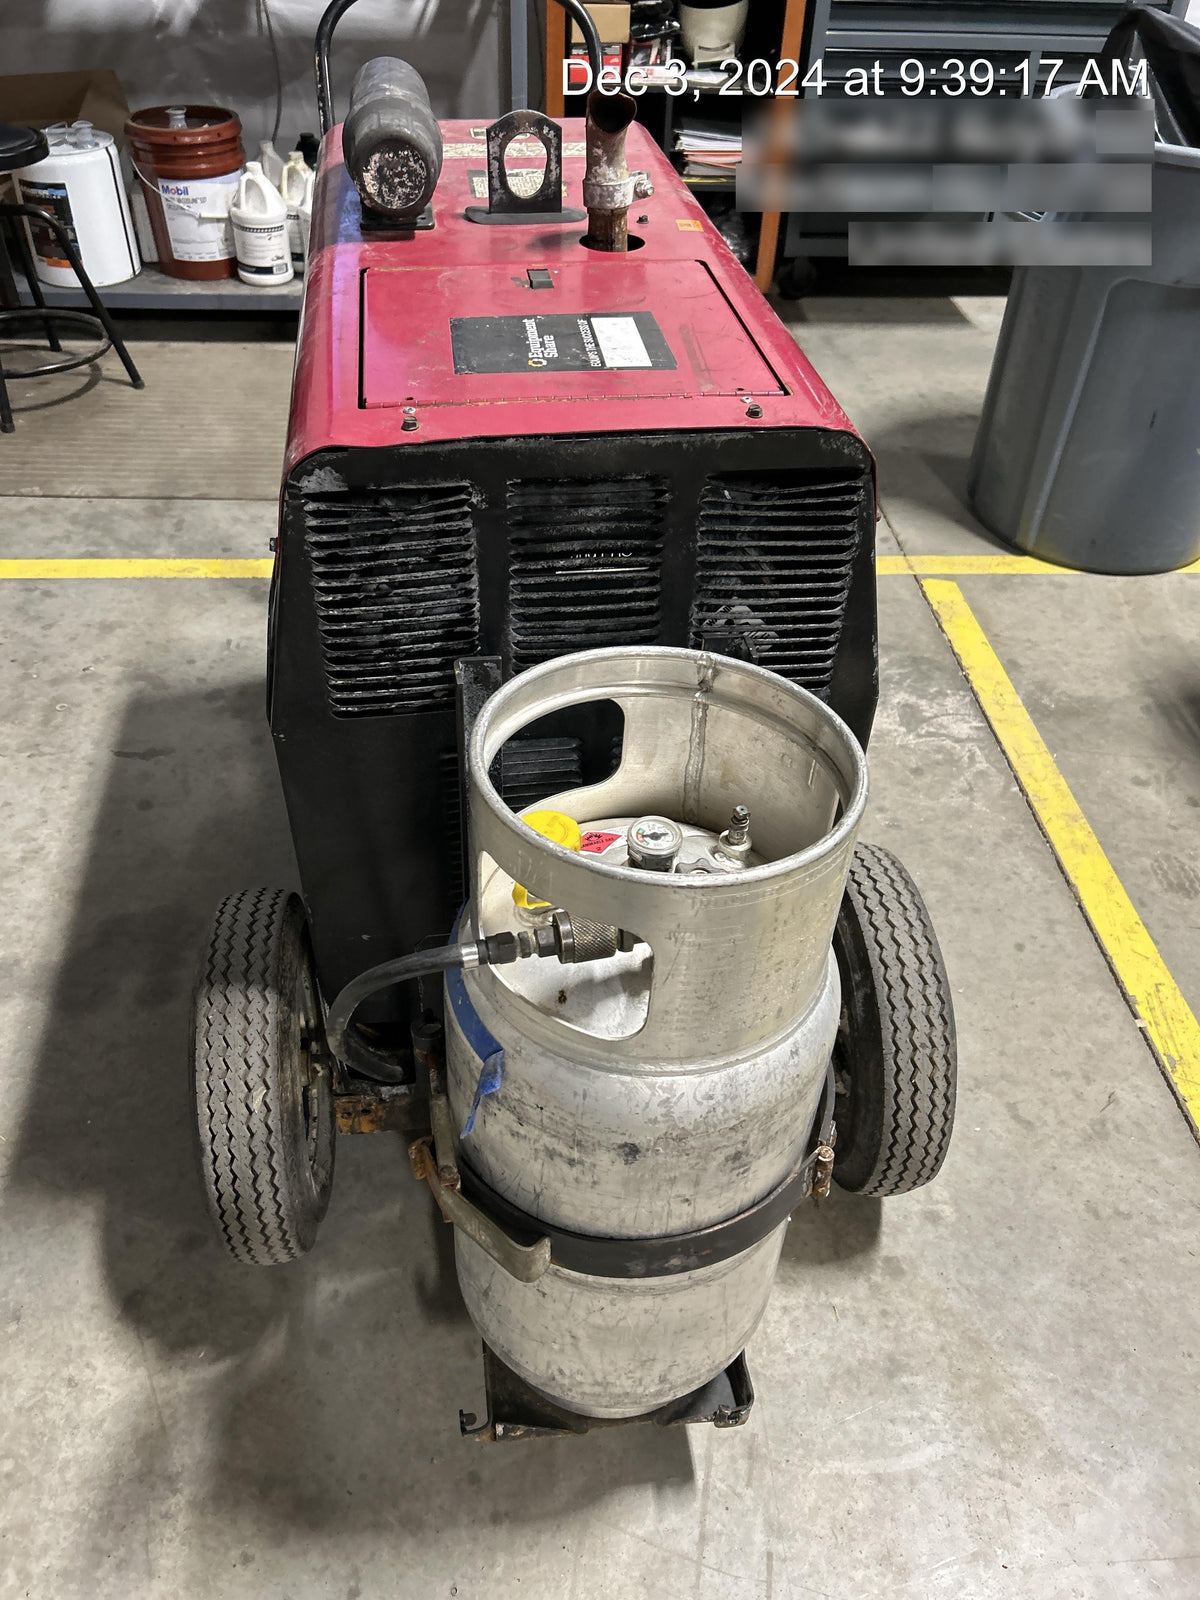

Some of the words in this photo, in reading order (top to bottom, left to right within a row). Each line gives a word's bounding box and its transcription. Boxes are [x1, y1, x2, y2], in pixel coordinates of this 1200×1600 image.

[161, 184, 189, 196] Mobil
[523, 318, 544, 358] Equipment
[543, 334, 559, 358] Share
